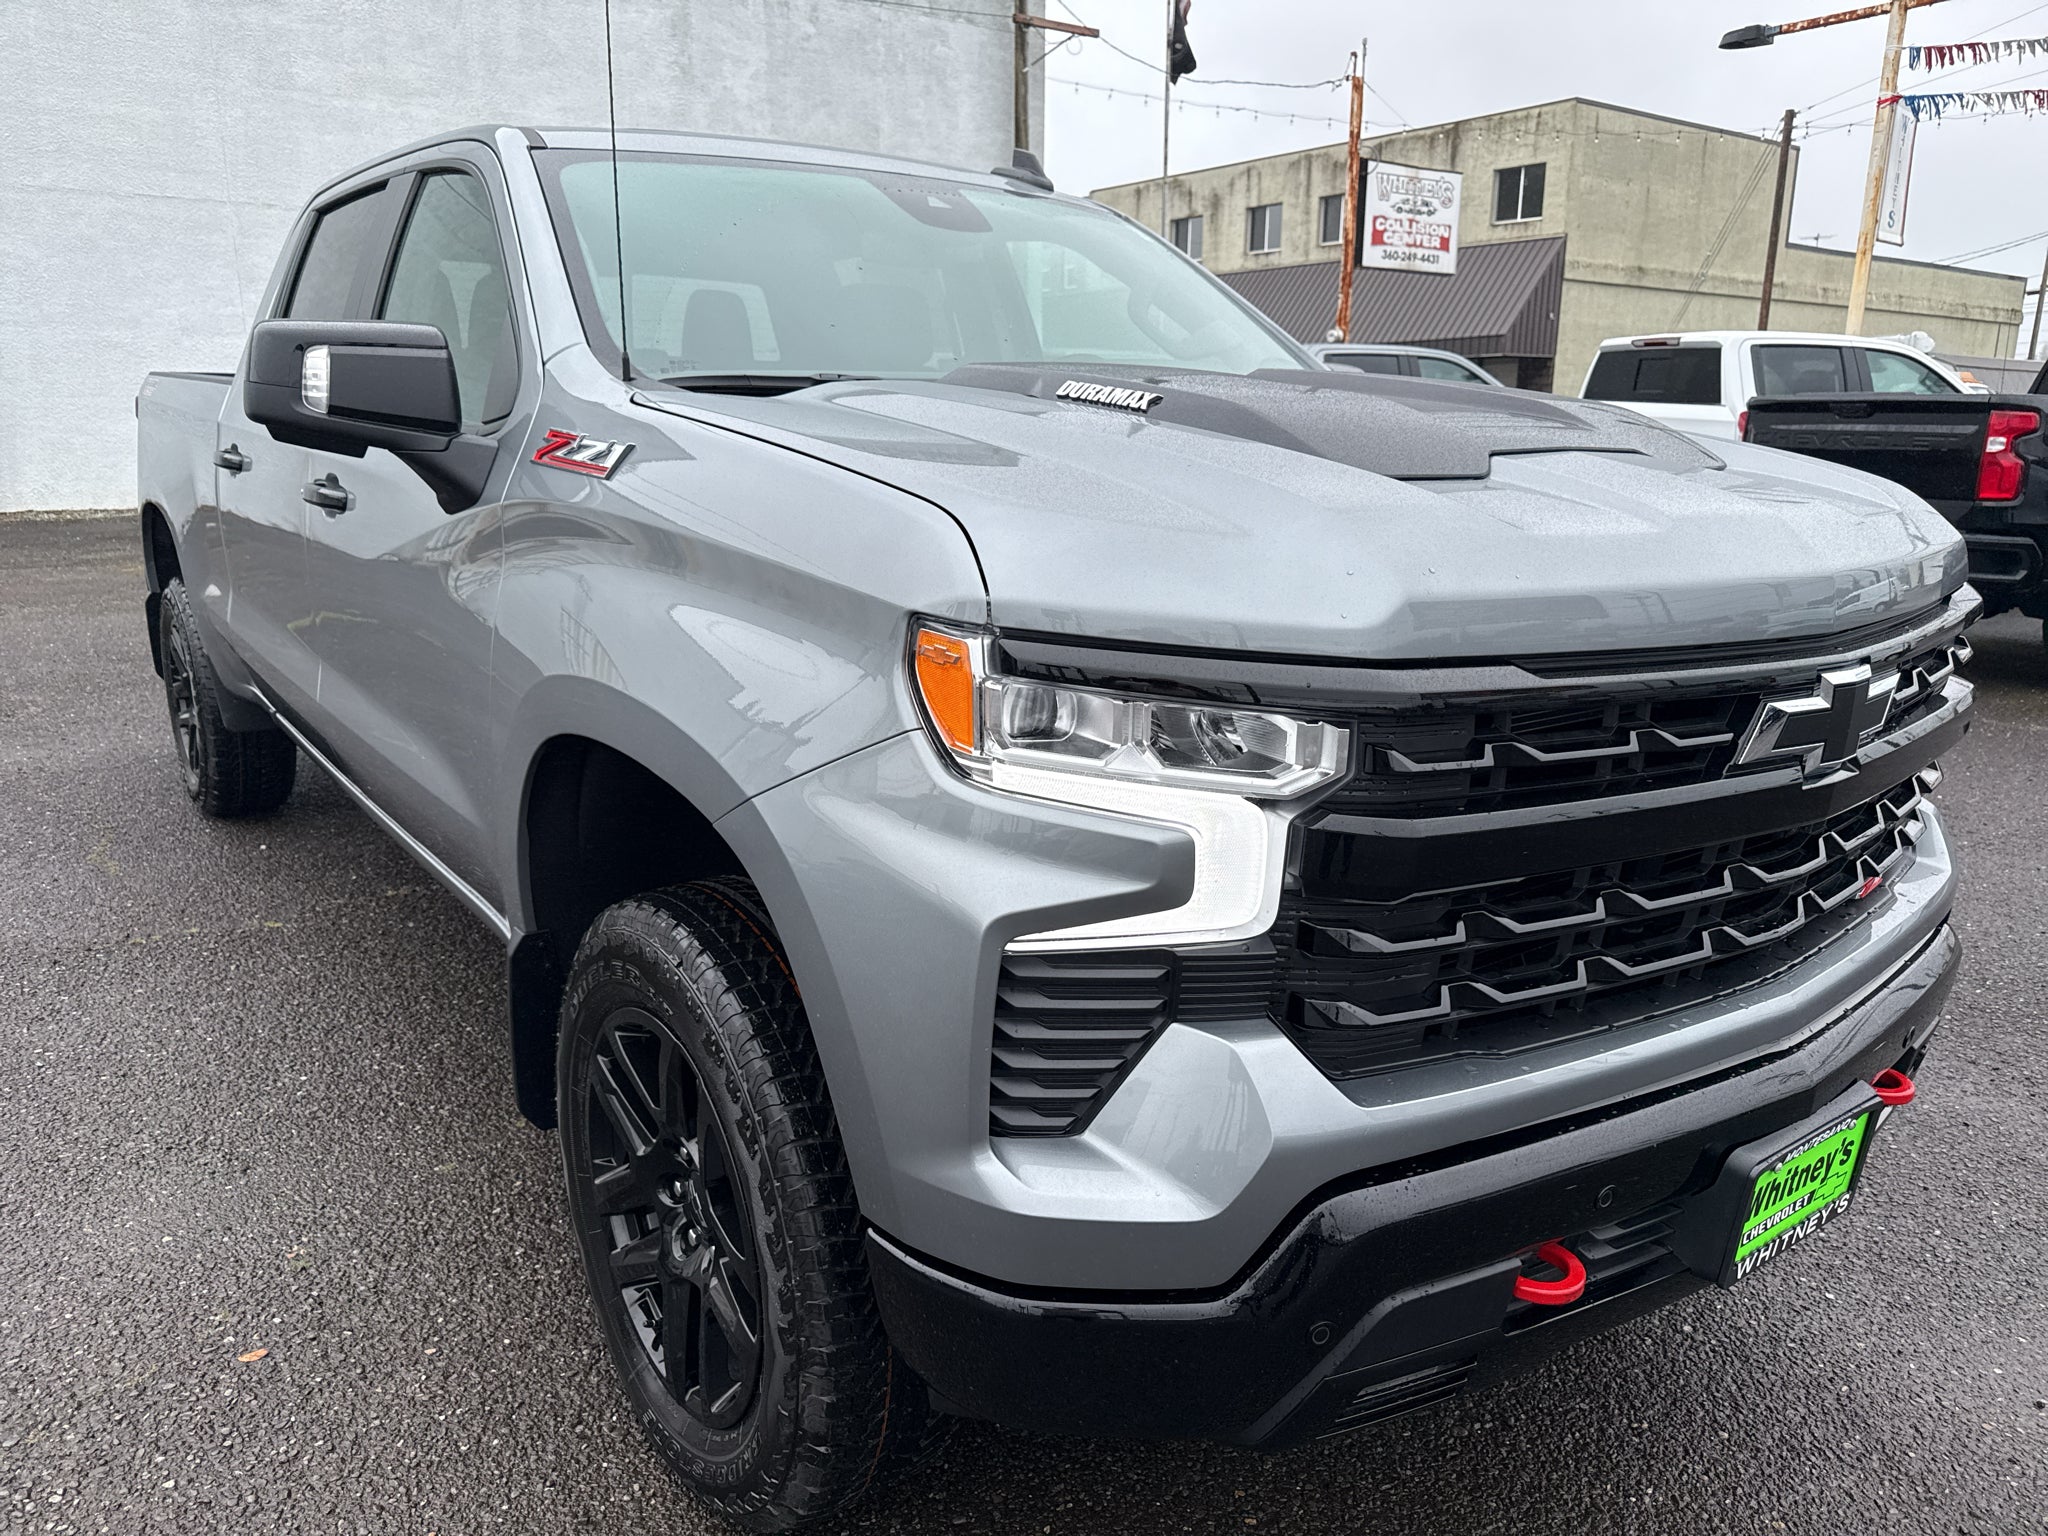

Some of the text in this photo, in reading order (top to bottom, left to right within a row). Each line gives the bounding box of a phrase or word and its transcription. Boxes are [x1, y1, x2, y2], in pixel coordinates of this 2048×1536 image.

[1375, 215, 1450, 238] COLLISION
[1383, 231, 1441, 249] CENTER
[1381, 249, 1440, 265] 360-249-4431
[1055, 380, 1164, 413] DURAMAX
[531, 427, 637, 480] Z71
[1750, 1136, 1855, 1218] Whitney's
[1736, 1193, 1850, 1280] WHITNEY'S
[1742, 1193, 1811, 1245] CHEVROLET
